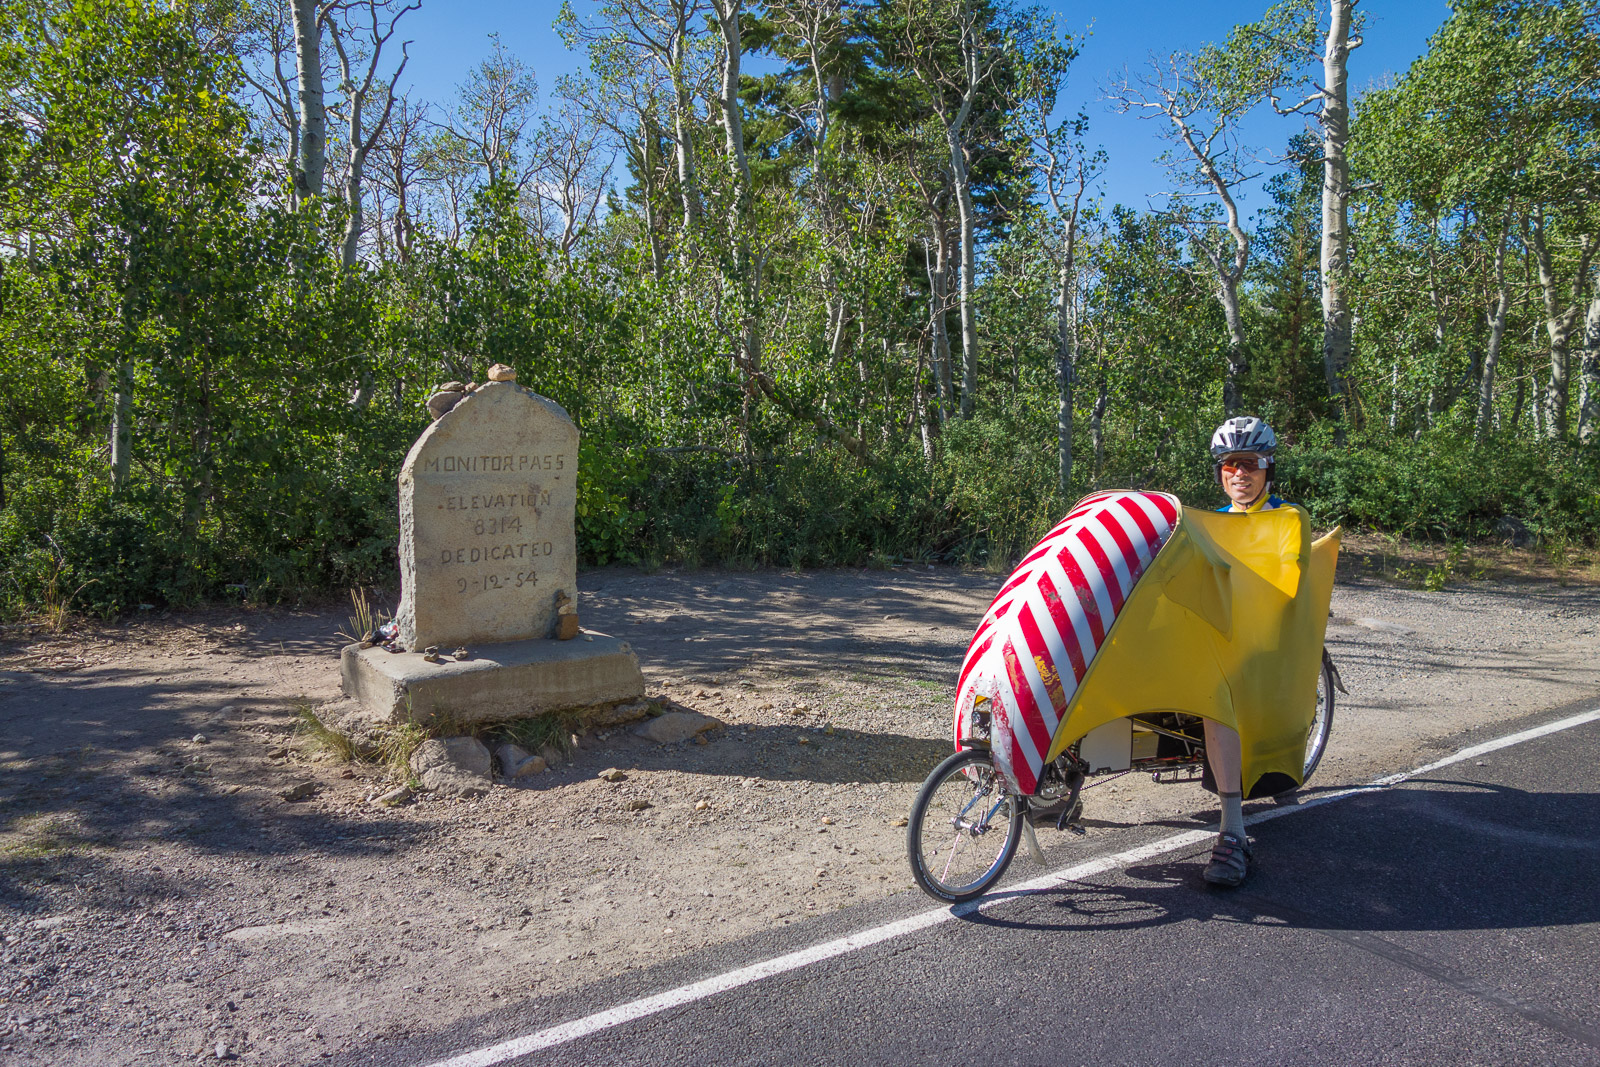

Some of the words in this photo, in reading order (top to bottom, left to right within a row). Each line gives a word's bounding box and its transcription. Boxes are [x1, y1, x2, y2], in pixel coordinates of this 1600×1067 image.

[424, 455, 514, 472] MONITOR
[519, 454, 564, 471] PASS
[446, 493, 551, 511] ELEVATION
[474, 516, 523, 536] 8314
[441, 541, 553, 564] DEDICATED
[457, 571, 539, 594] 9-12-54
